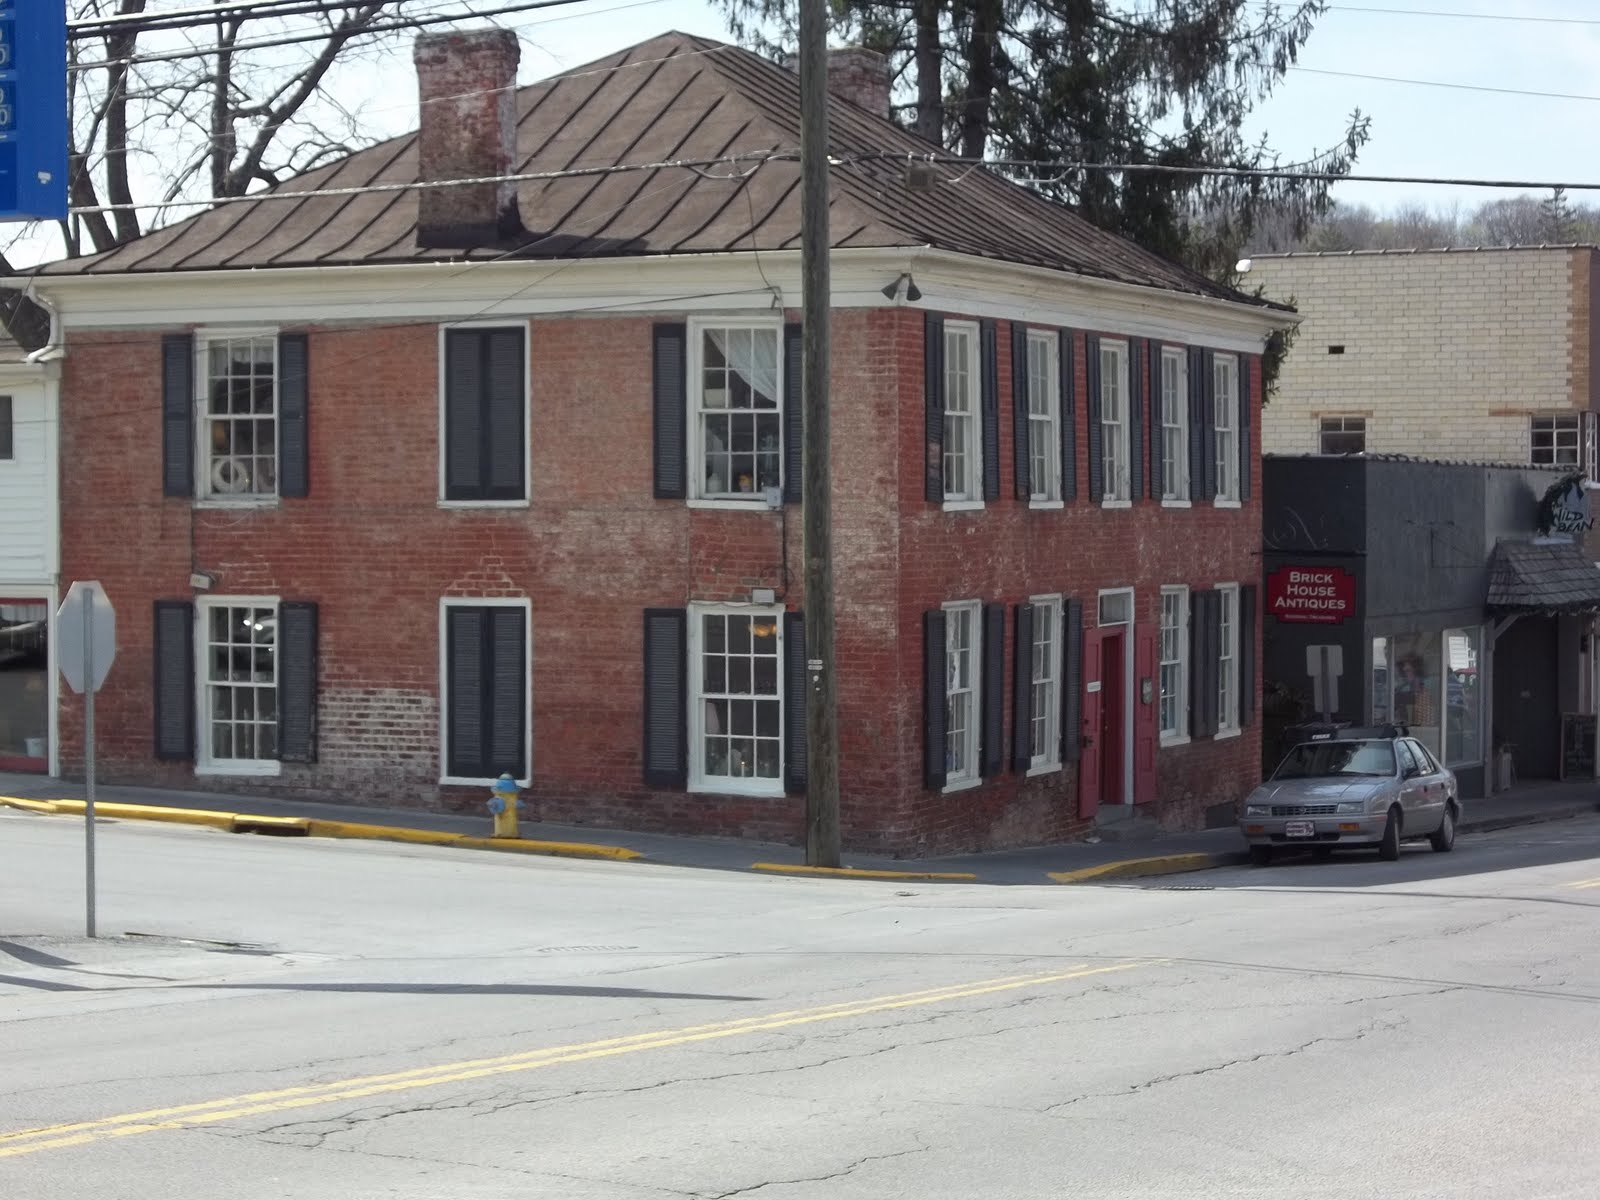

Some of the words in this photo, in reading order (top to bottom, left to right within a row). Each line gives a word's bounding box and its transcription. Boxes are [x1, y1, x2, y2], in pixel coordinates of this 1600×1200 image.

[1289, 571, 1333, 584] BRICK
[1287, 584, 1336, 597] HOUSE
[1274, 596, 1346, 610] ANTIQUES
